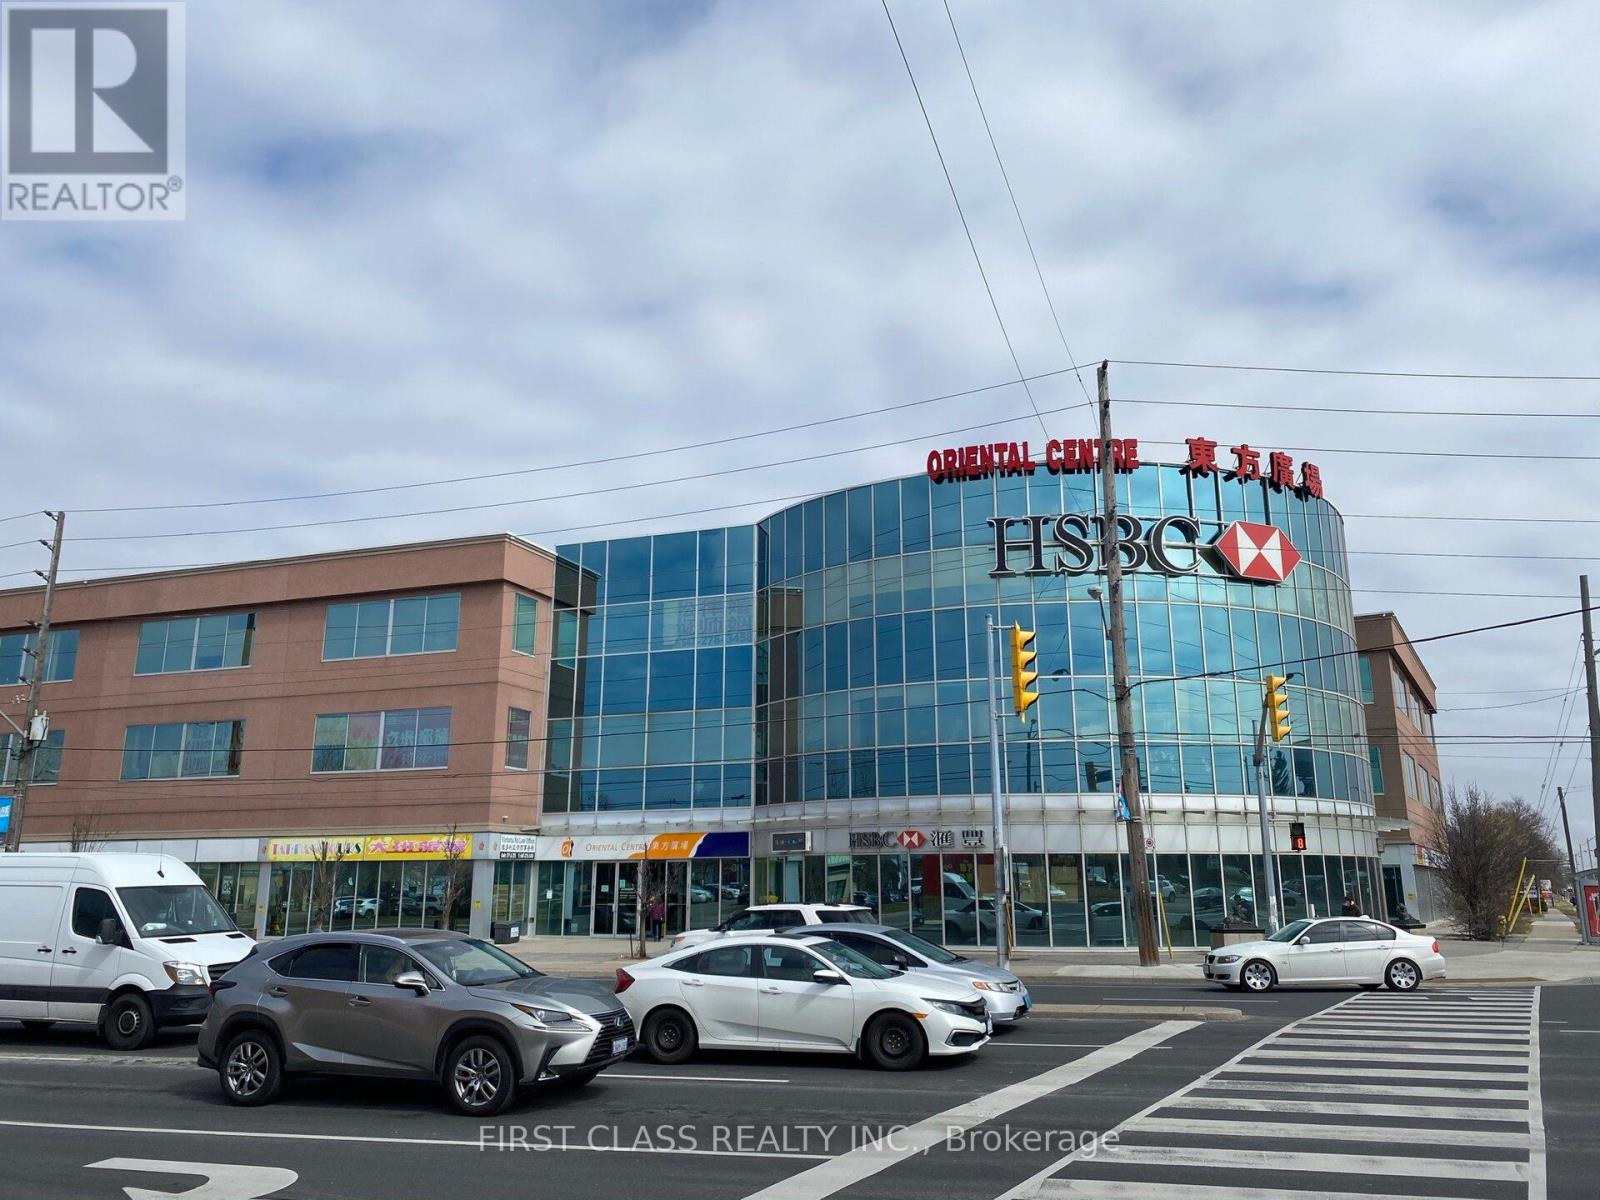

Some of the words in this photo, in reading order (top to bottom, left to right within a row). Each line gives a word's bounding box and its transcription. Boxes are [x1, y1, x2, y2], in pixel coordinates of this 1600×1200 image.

[927, 441, 1036, 482] ORIENTAL
[1185, 437, 1324, 498] 東方廣場
[986, 513, 1203, 575] HSBC
[849, 831, 897, 849] HSBC
